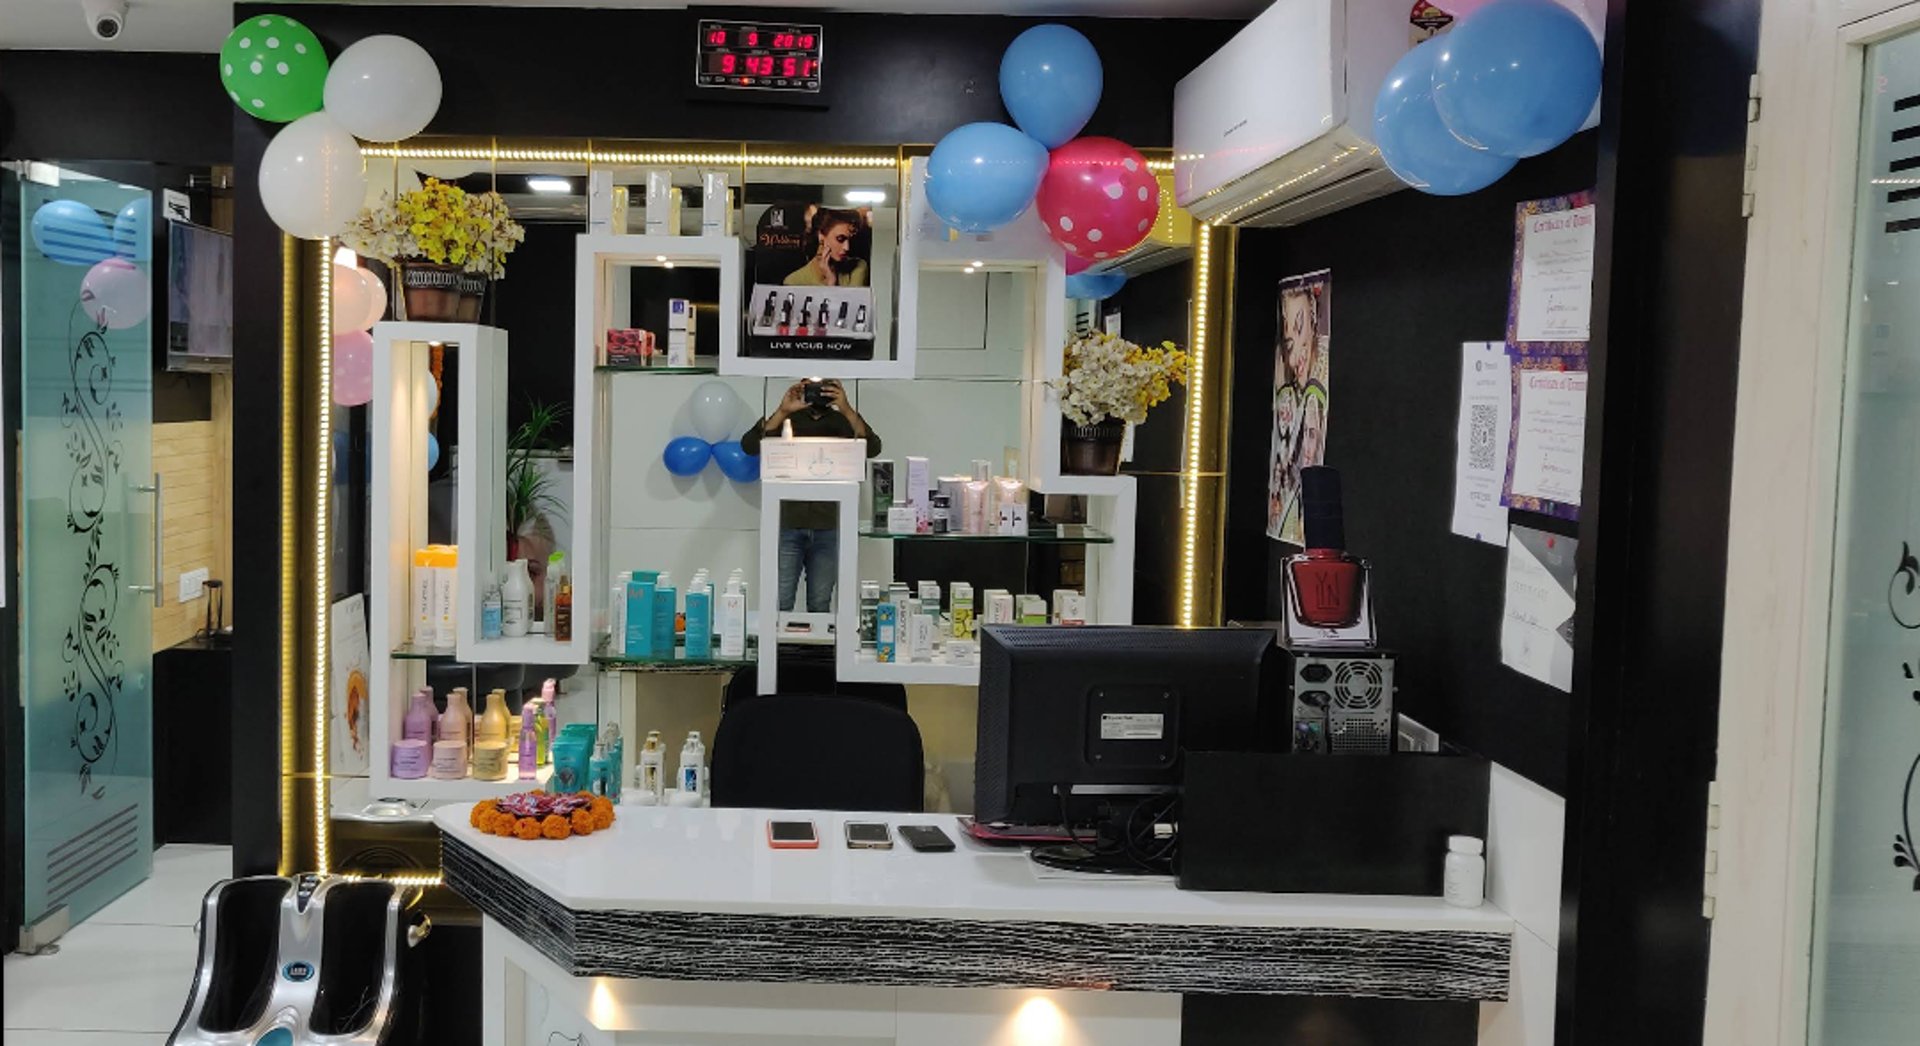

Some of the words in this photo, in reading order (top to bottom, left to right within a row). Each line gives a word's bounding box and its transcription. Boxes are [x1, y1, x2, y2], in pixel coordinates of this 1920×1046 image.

[709, 31, 726, 46] 10
[773, 34, 814, 49] 2019
[795, 342, 824, 350] YOUR
[827, 343, 852, 351] NOW
